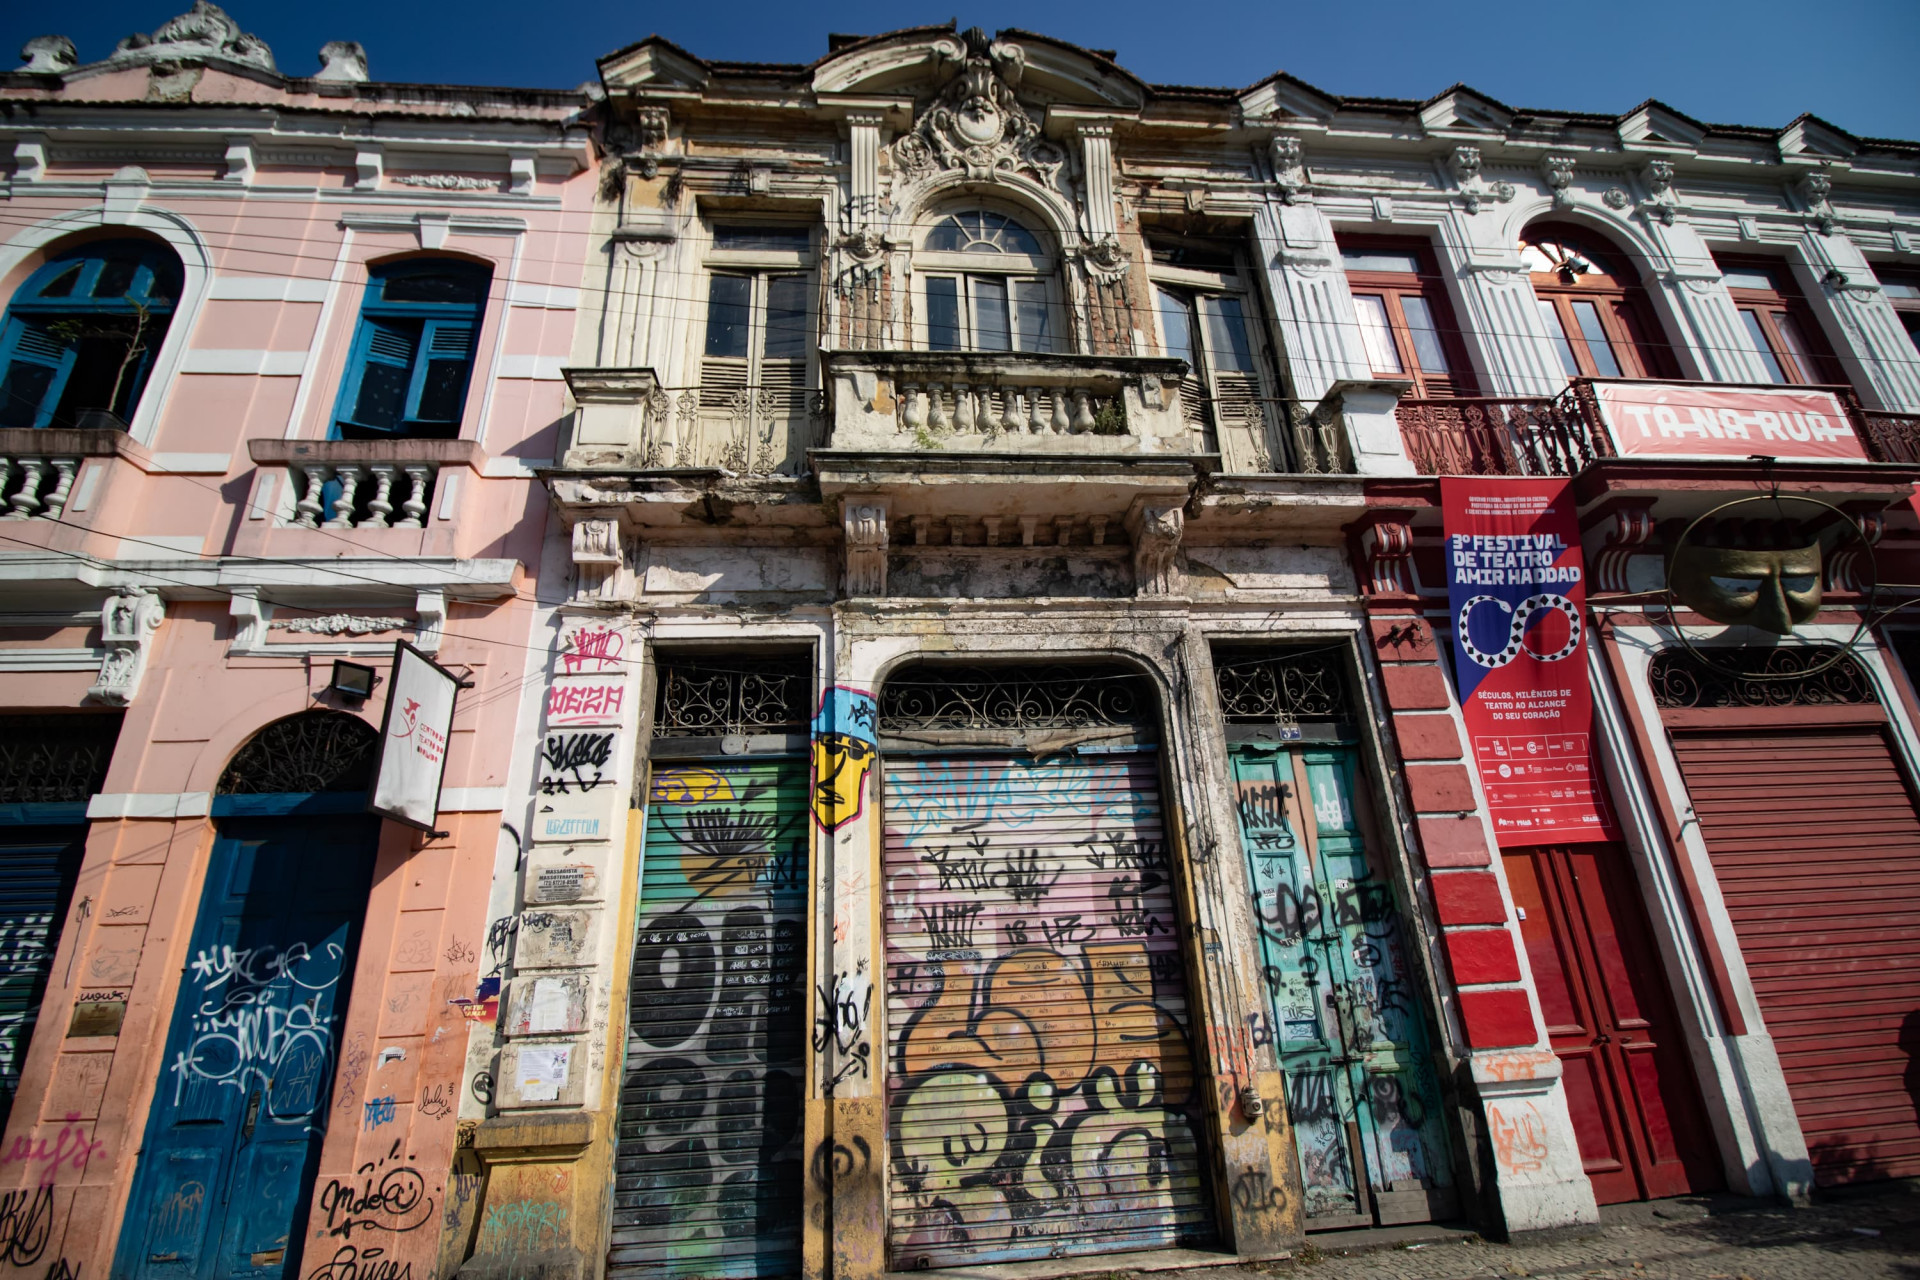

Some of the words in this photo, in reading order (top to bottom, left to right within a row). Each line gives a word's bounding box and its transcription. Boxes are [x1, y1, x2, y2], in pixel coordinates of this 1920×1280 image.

[1623, 396, 1685, 439] TÁ
[1690, 407, 1751, 441] NA
[1754, 409, 1850, 443] RUA
[1451, 533, 1470, 550] 3º
[1473, 533, 1568, 551] FESTIVAL
[1453, 551, 1477, 567] DE
[1480, 551, 1553, 568] TEATRO
[1455, 568, 1504, 585] AMIR
[1507, 566, 1581, 585] HADDAD
[1477, 690, 1514, 700] SÉCULOS,
[1515, 689, 1558, 699] MILÊNIOS
[1560, 689, 1572, 697] DE
[1528, 699, 1567, 709] ALCANCE
[1492, 712, 1504, 720] DO
[1505, 712, 1521, 720] SEU
[1522, 709, 1560, 719] CORAÇÃO
